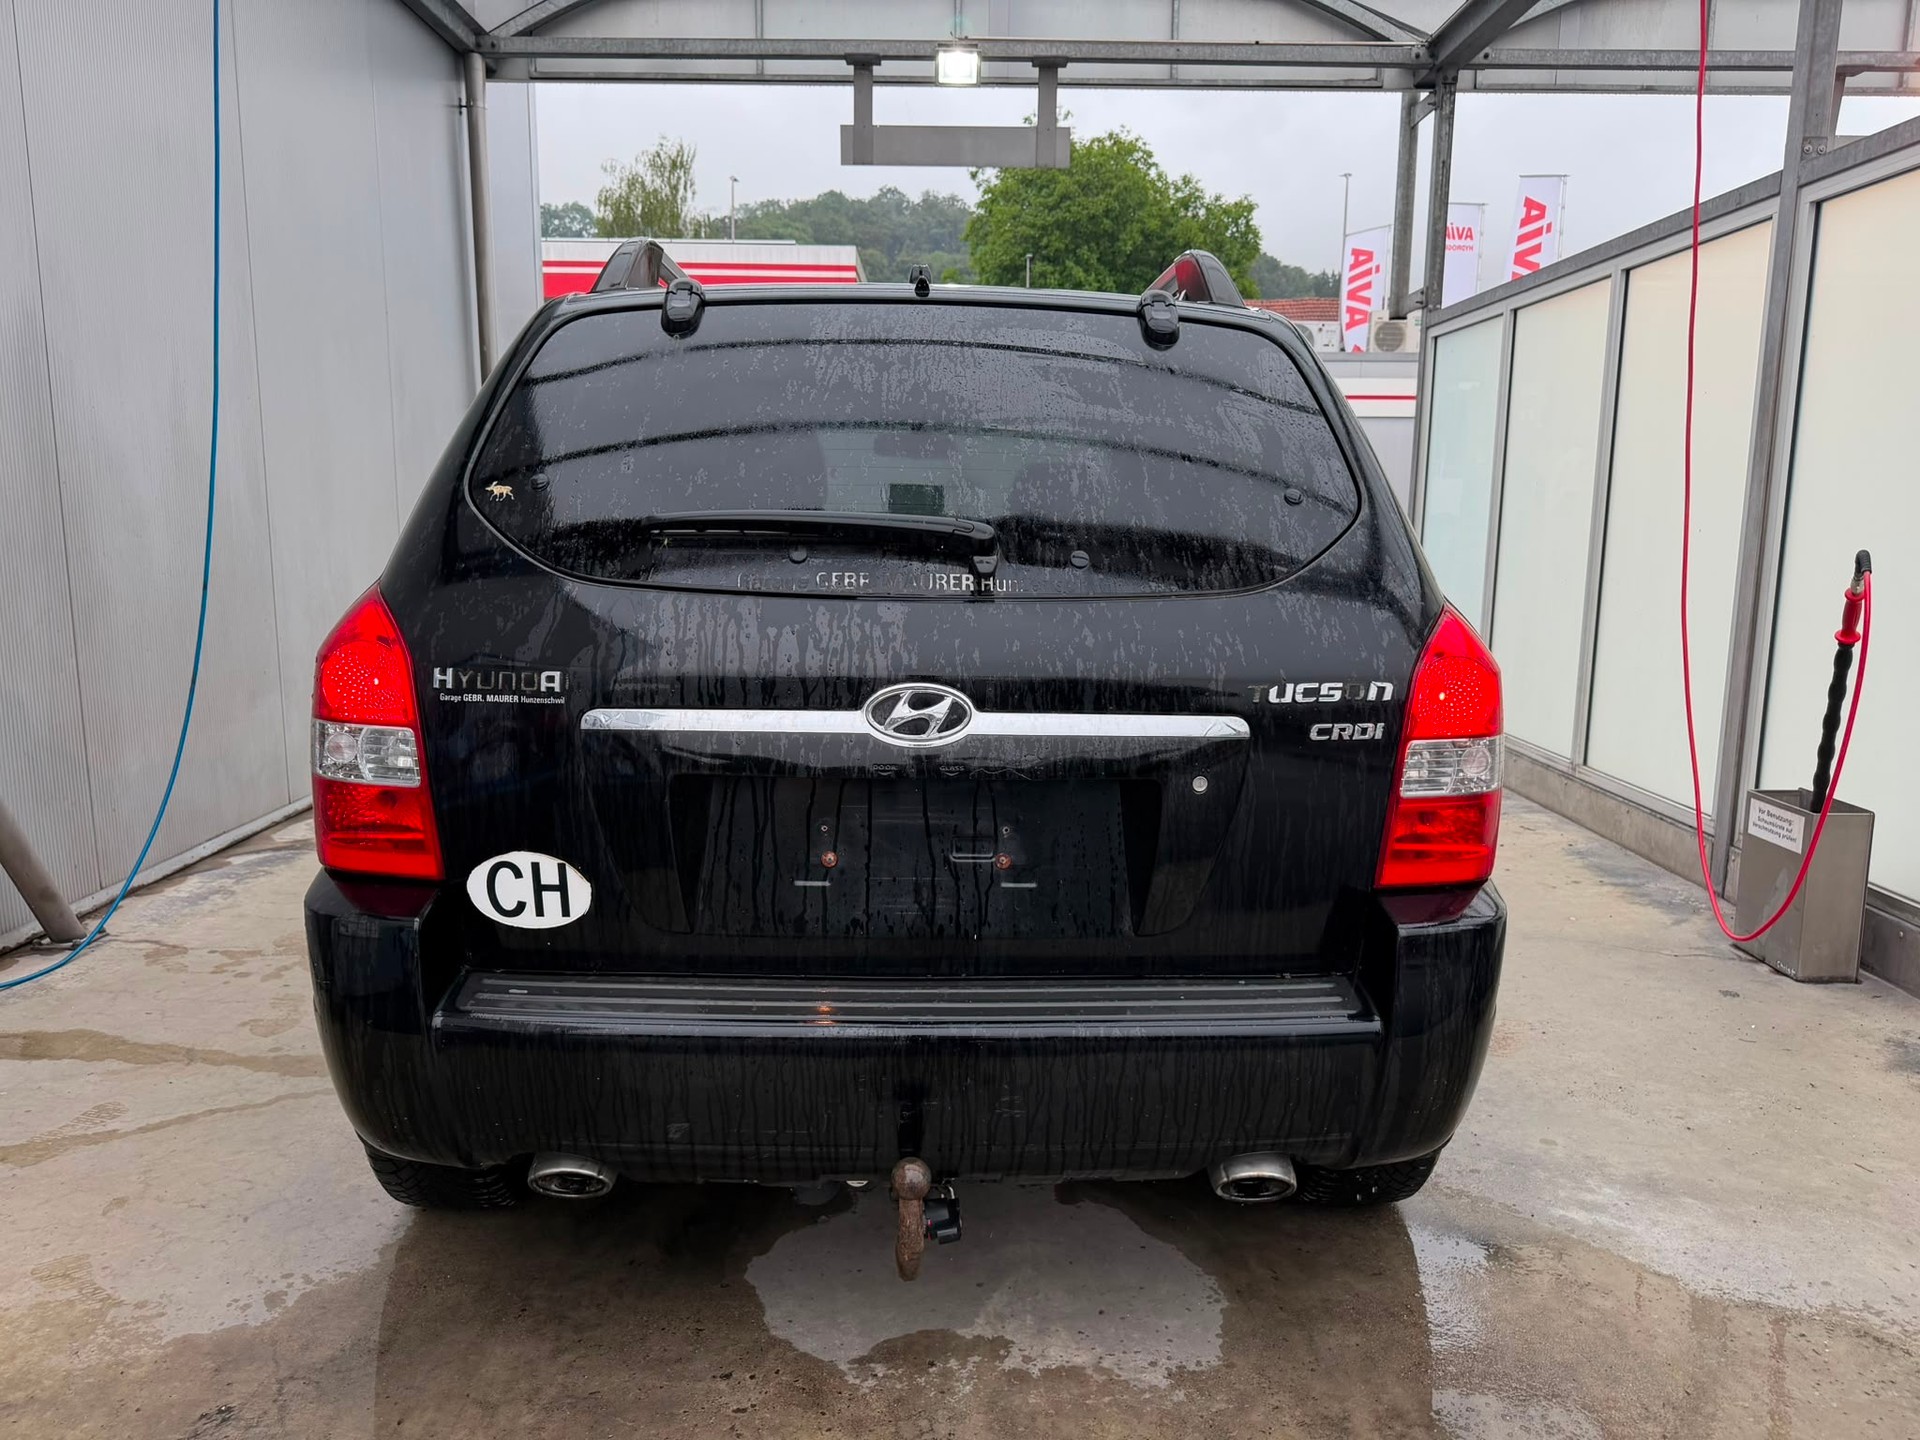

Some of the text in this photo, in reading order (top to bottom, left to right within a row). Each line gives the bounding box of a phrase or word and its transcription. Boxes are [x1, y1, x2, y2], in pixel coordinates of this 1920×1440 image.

[439, 693, 566, 704] Garage GEBR. MAURER Hunzenschwil
[1247, 681, 1394, 704] TUCSON
[486, 860, 571, 918] CH
